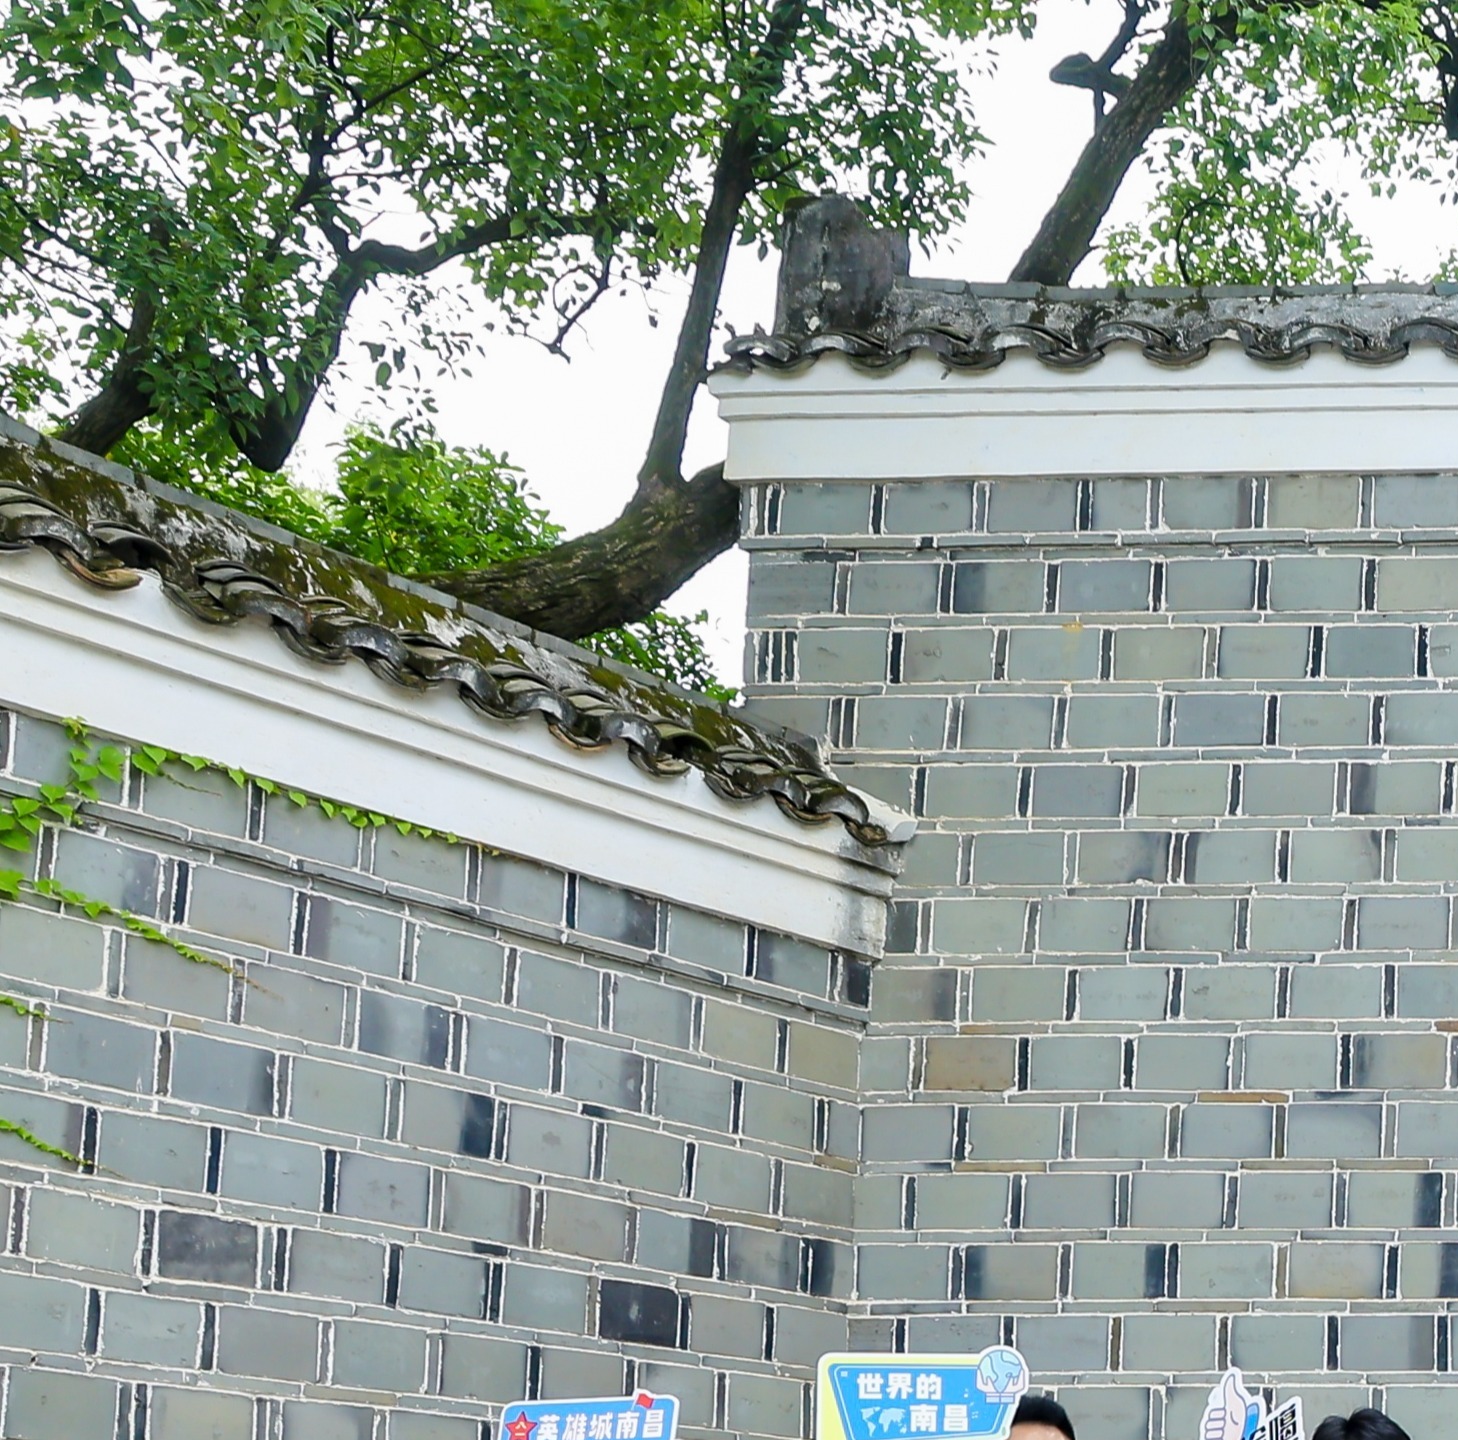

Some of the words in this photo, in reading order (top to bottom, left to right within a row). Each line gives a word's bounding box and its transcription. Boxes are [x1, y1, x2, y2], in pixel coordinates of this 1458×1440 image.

[856, 1372, 942, 1400] 世界的
[909, 1403, 969, 1433] 南昌
